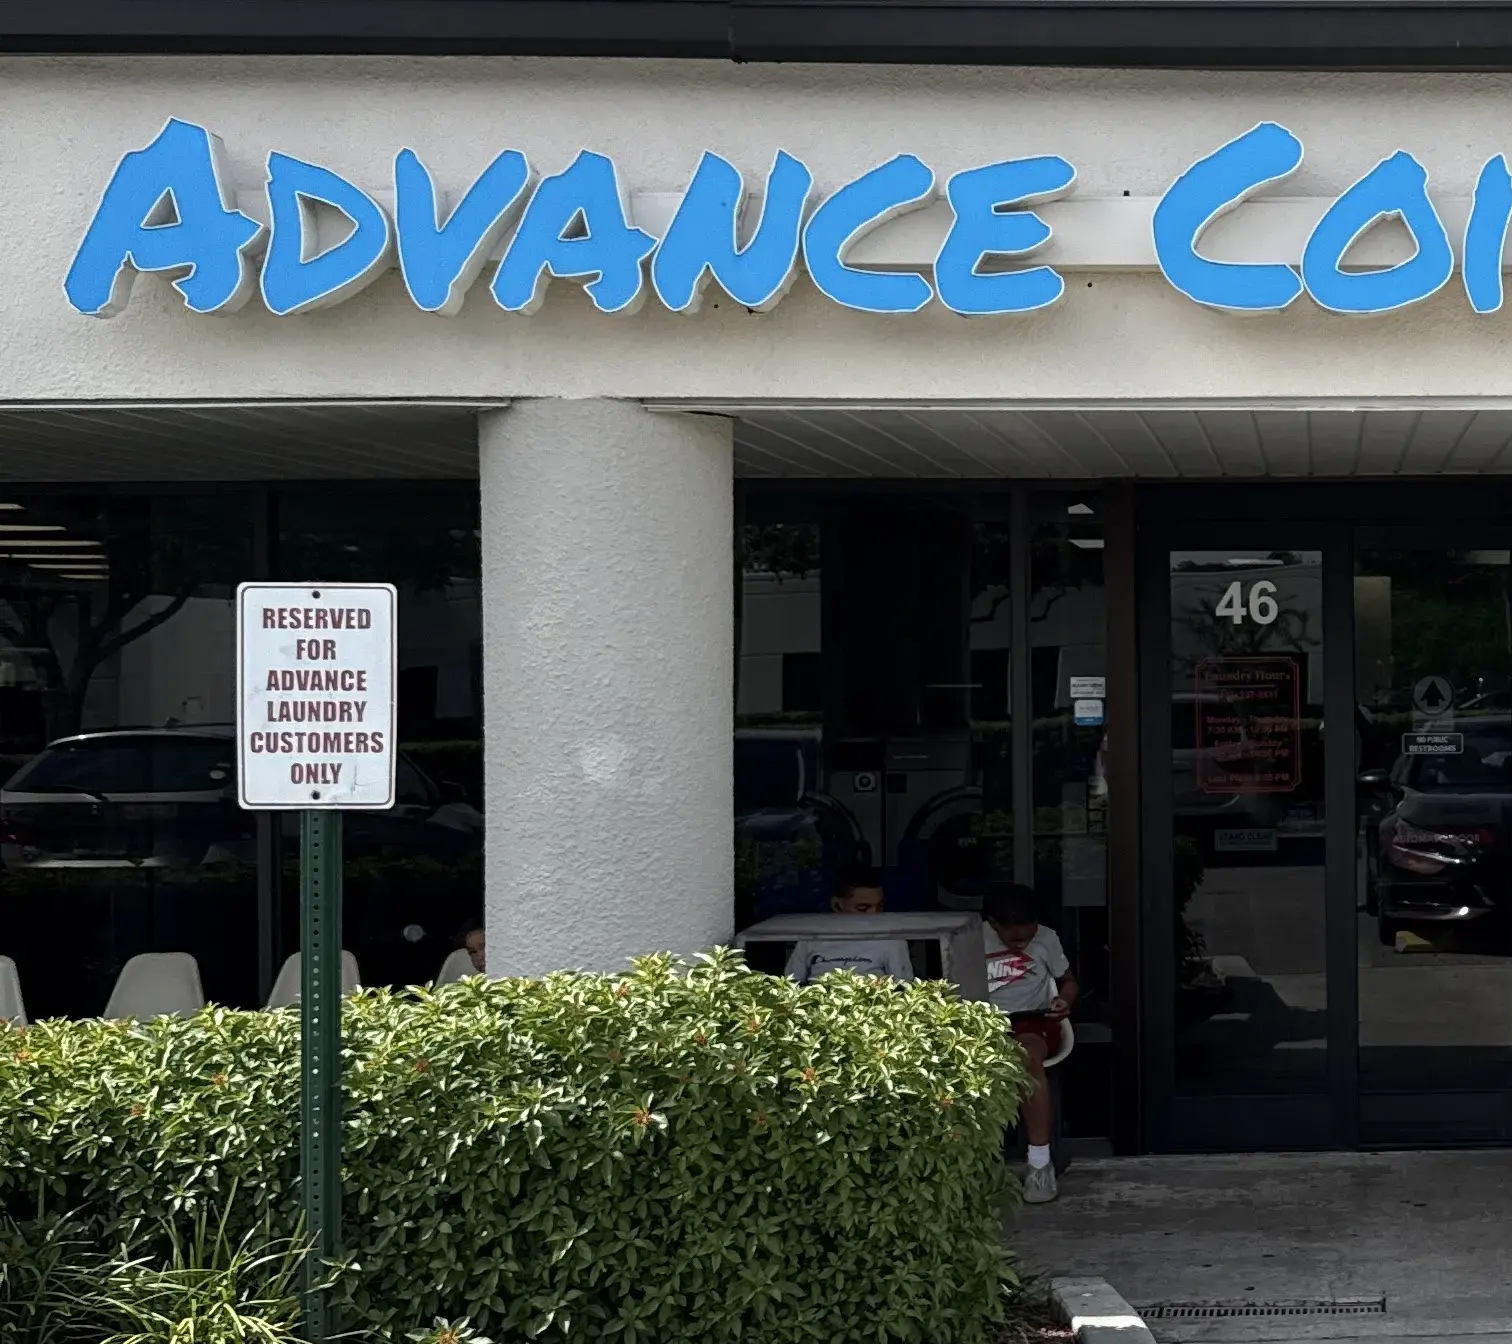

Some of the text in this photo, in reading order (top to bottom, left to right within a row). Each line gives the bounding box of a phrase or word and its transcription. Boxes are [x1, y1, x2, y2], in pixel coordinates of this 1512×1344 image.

[64, 116, 1077, 316] ADVANCE
[1215, 579, 1279, 625] 46
[262, 608, 371, 629] RESERVED
[296, 639, 337, 660] FOR
[266, 670, 367, 691] ADVANCE
[267, 701, 367, 722] LAUNDRY
[250, 732, 384, 753] CUSTOMERS
[290, 763, 342, 784] ONLY
